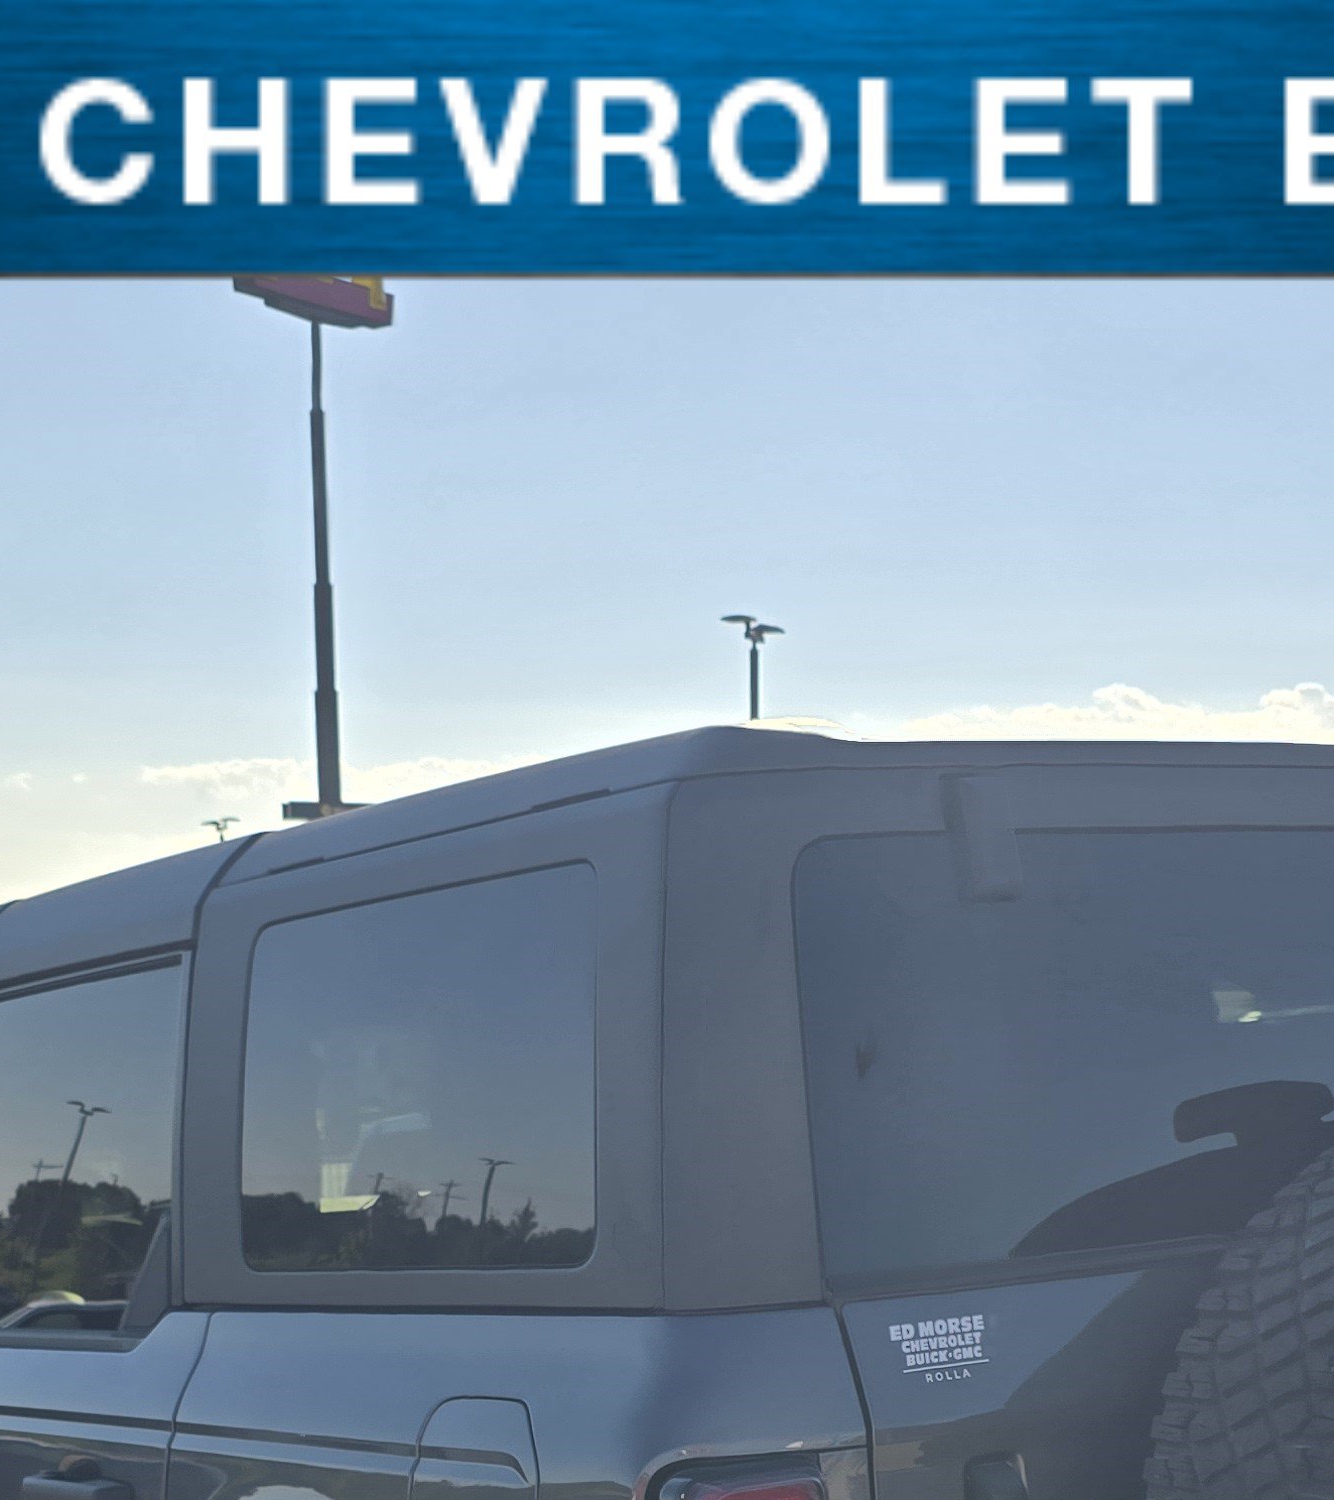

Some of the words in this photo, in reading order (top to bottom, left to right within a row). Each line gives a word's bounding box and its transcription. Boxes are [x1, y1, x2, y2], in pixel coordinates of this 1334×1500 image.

[888, 1323, 916, 1342] ED
[918, 1314, 985, 1338] MORSE
[901, 1331, 983, 1354] CHEVROLET
[925, 1368, 971, 1383] ROLLA
